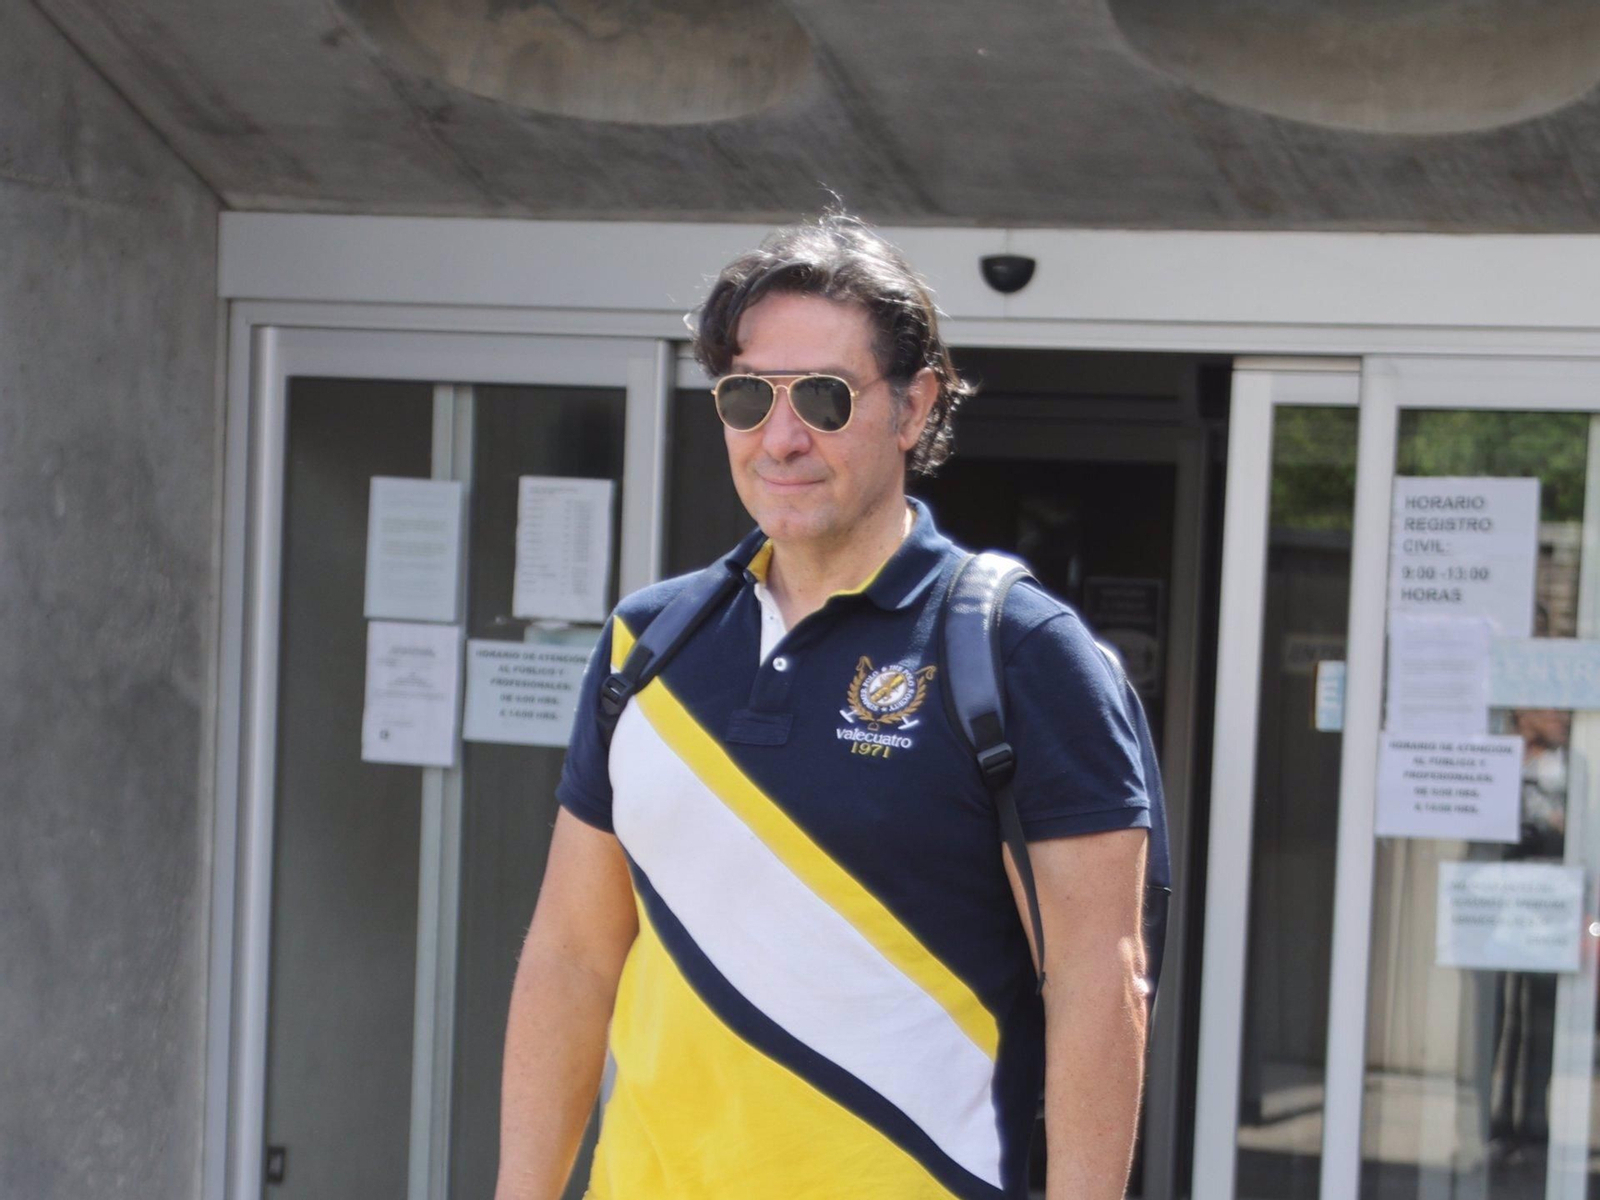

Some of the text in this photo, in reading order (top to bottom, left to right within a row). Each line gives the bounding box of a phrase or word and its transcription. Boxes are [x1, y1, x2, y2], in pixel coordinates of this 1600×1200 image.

[1404, 495, 1485, 510] HORARIO
[1403, 517, 1493, 532] REGISTRO
[1400, 587, 1462, 602] HORAS
[862, 670, 880, 687] POLO
[902, 668, 915, 686] POLO
[889, 688, 915, 712] SOCIETY
[836, 728, 913, 749] valecuatro
[850, 741, 891, 759] 1971
